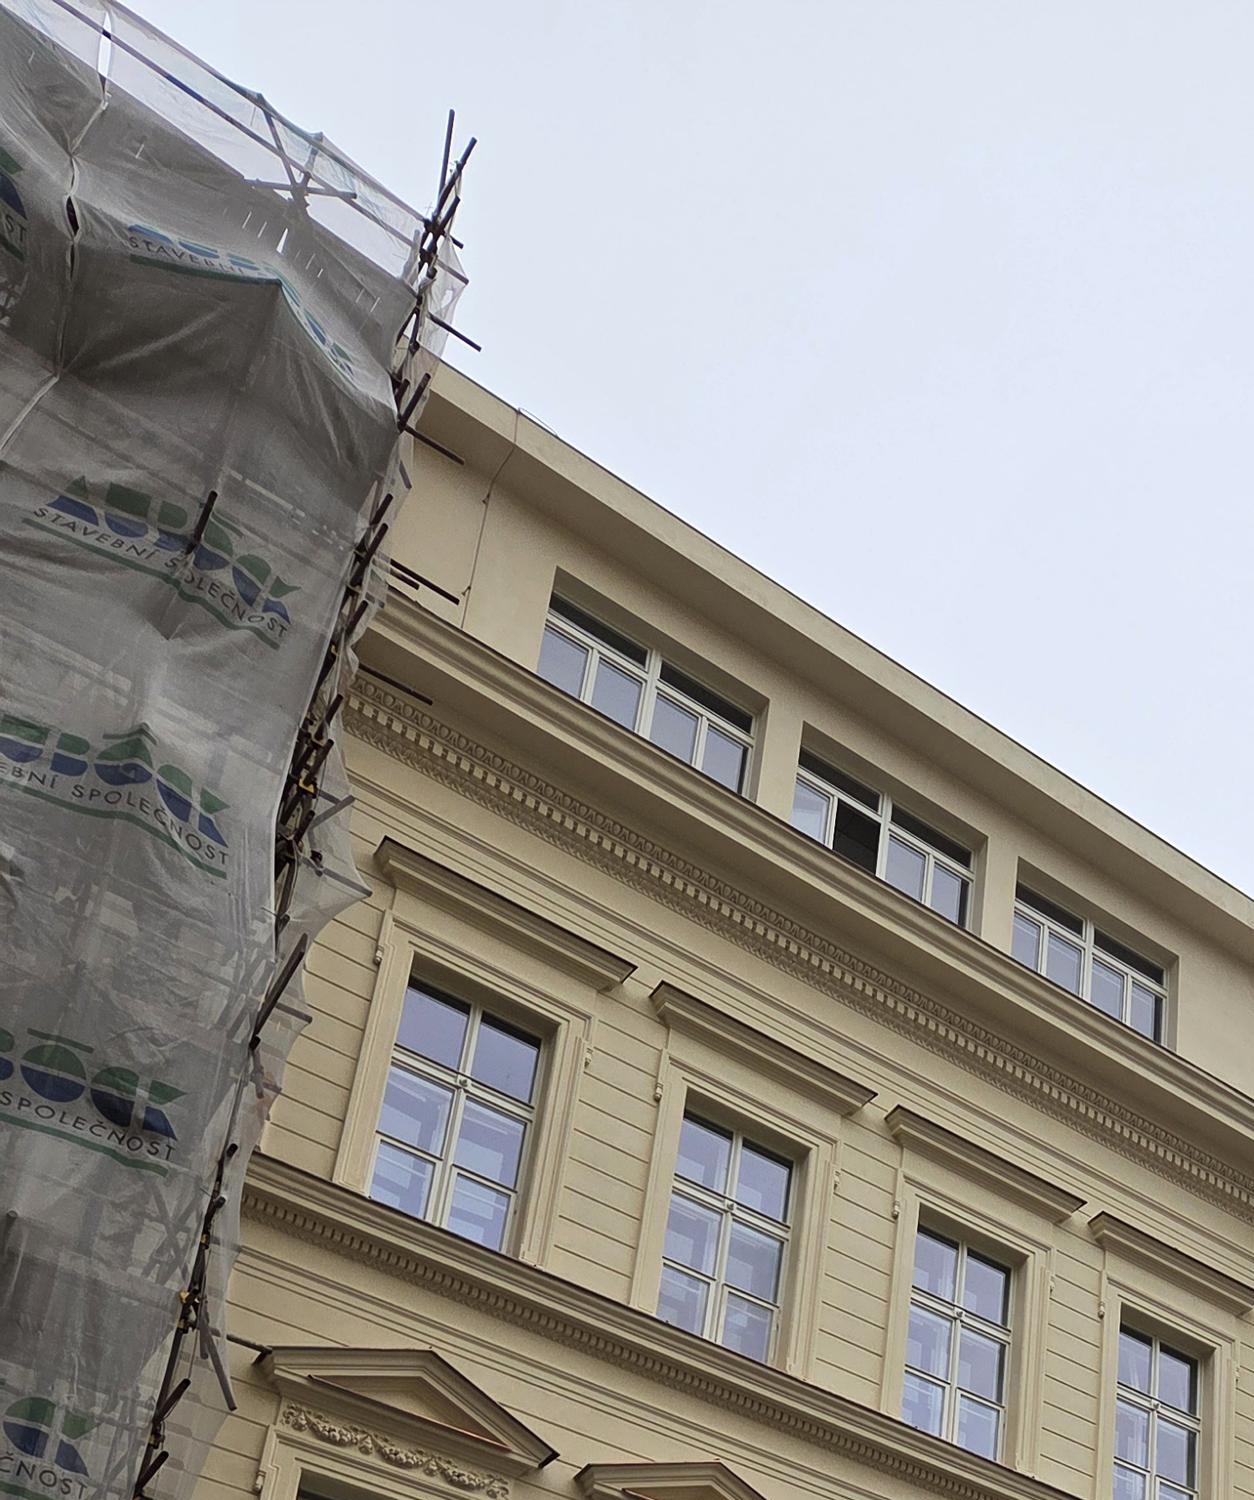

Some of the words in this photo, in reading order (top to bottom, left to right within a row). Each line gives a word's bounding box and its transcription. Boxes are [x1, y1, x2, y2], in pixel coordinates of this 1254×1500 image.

[33, 506, 160, 561] STAVEBNÍ
[164, 557, 288, 638] SOLEČNOST
[71, 783, 229, 866] SPOLEČNOST
[0, 1090, 176, 1161] SPOLEČNOST
